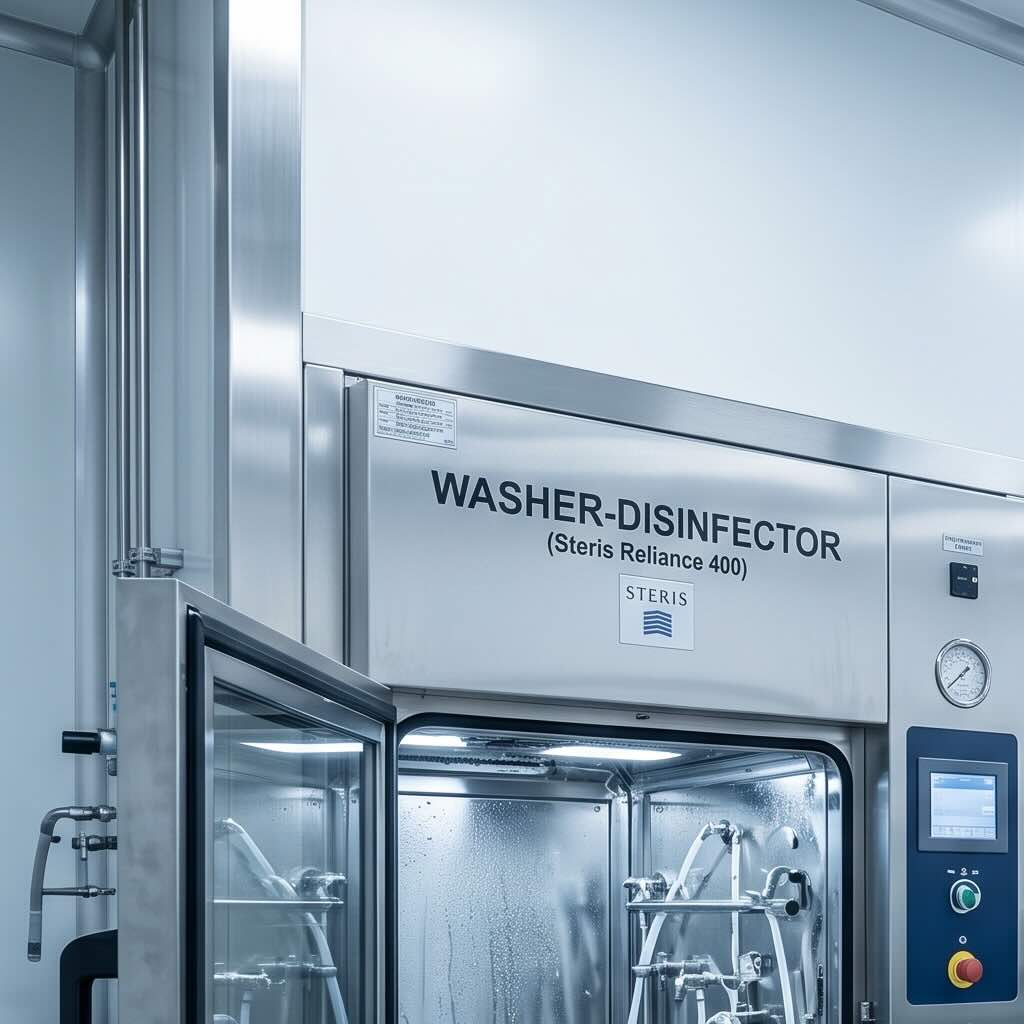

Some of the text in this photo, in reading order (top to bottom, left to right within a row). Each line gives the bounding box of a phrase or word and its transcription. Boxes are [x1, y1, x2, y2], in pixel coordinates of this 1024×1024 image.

[430, 469, 842, 562] WASHER-DISINFECTOR
[547, 531, 748, 582] (Steris Reliance 400)
[625, 585, 688, 607] STERIS
